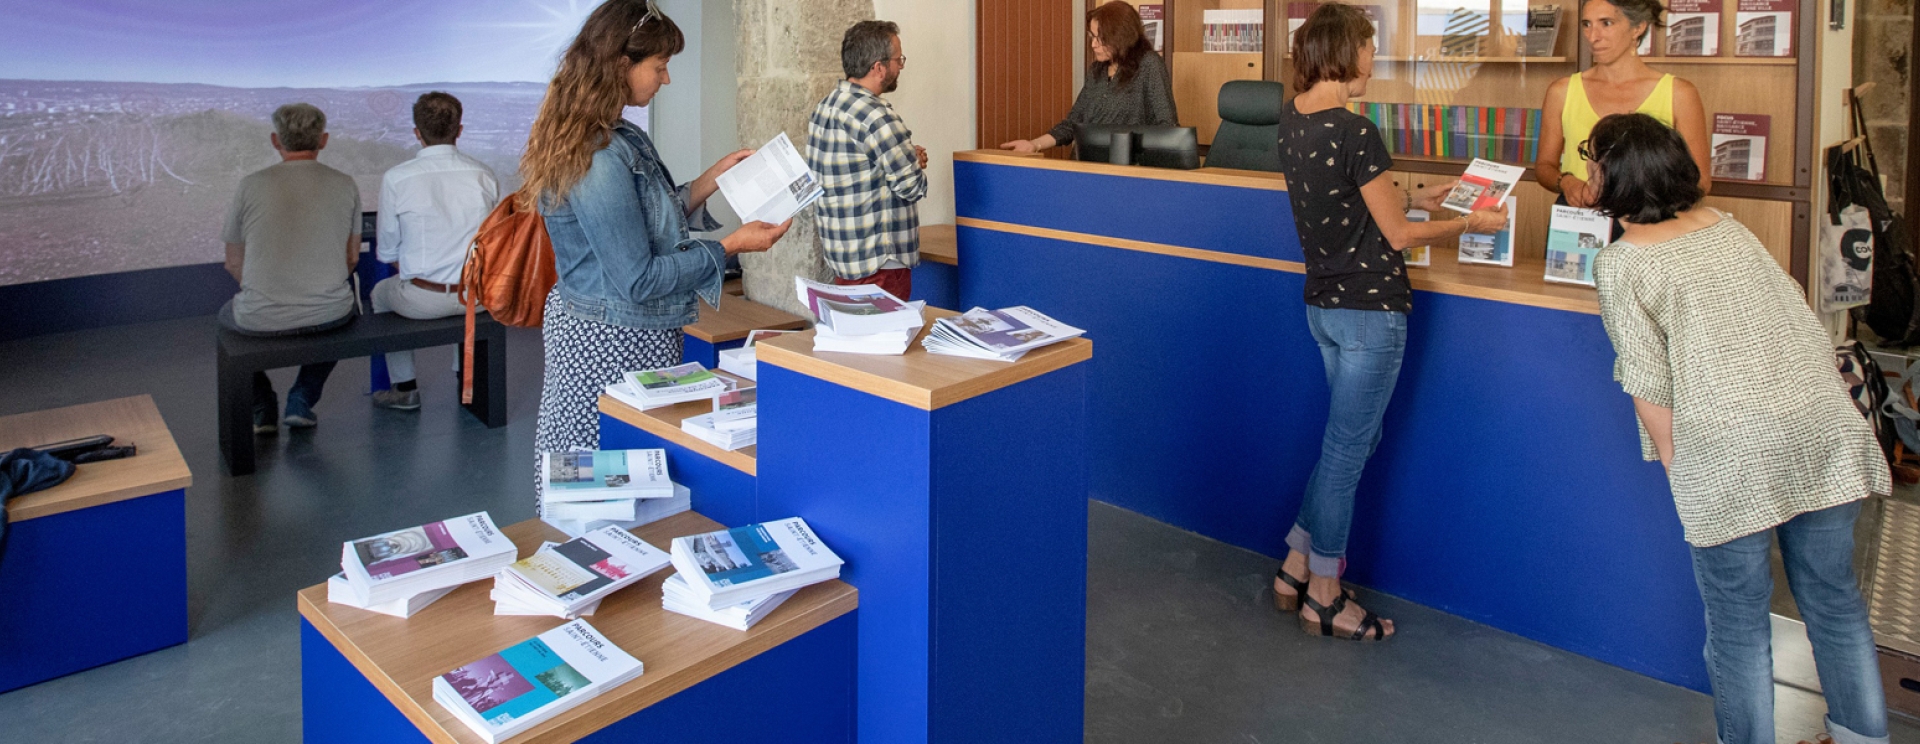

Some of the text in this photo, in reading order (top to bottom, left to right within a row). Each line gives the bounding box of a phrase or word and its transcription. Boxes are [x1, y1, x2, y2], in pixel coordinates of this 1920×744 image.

[1556, 208, 1584, 216] PARCOURS
[610, 527, 642, 546] PARCOURS
[792, 521, 816, 545] PARCOURS
[572, 622, 605, 649] PARCOURS
